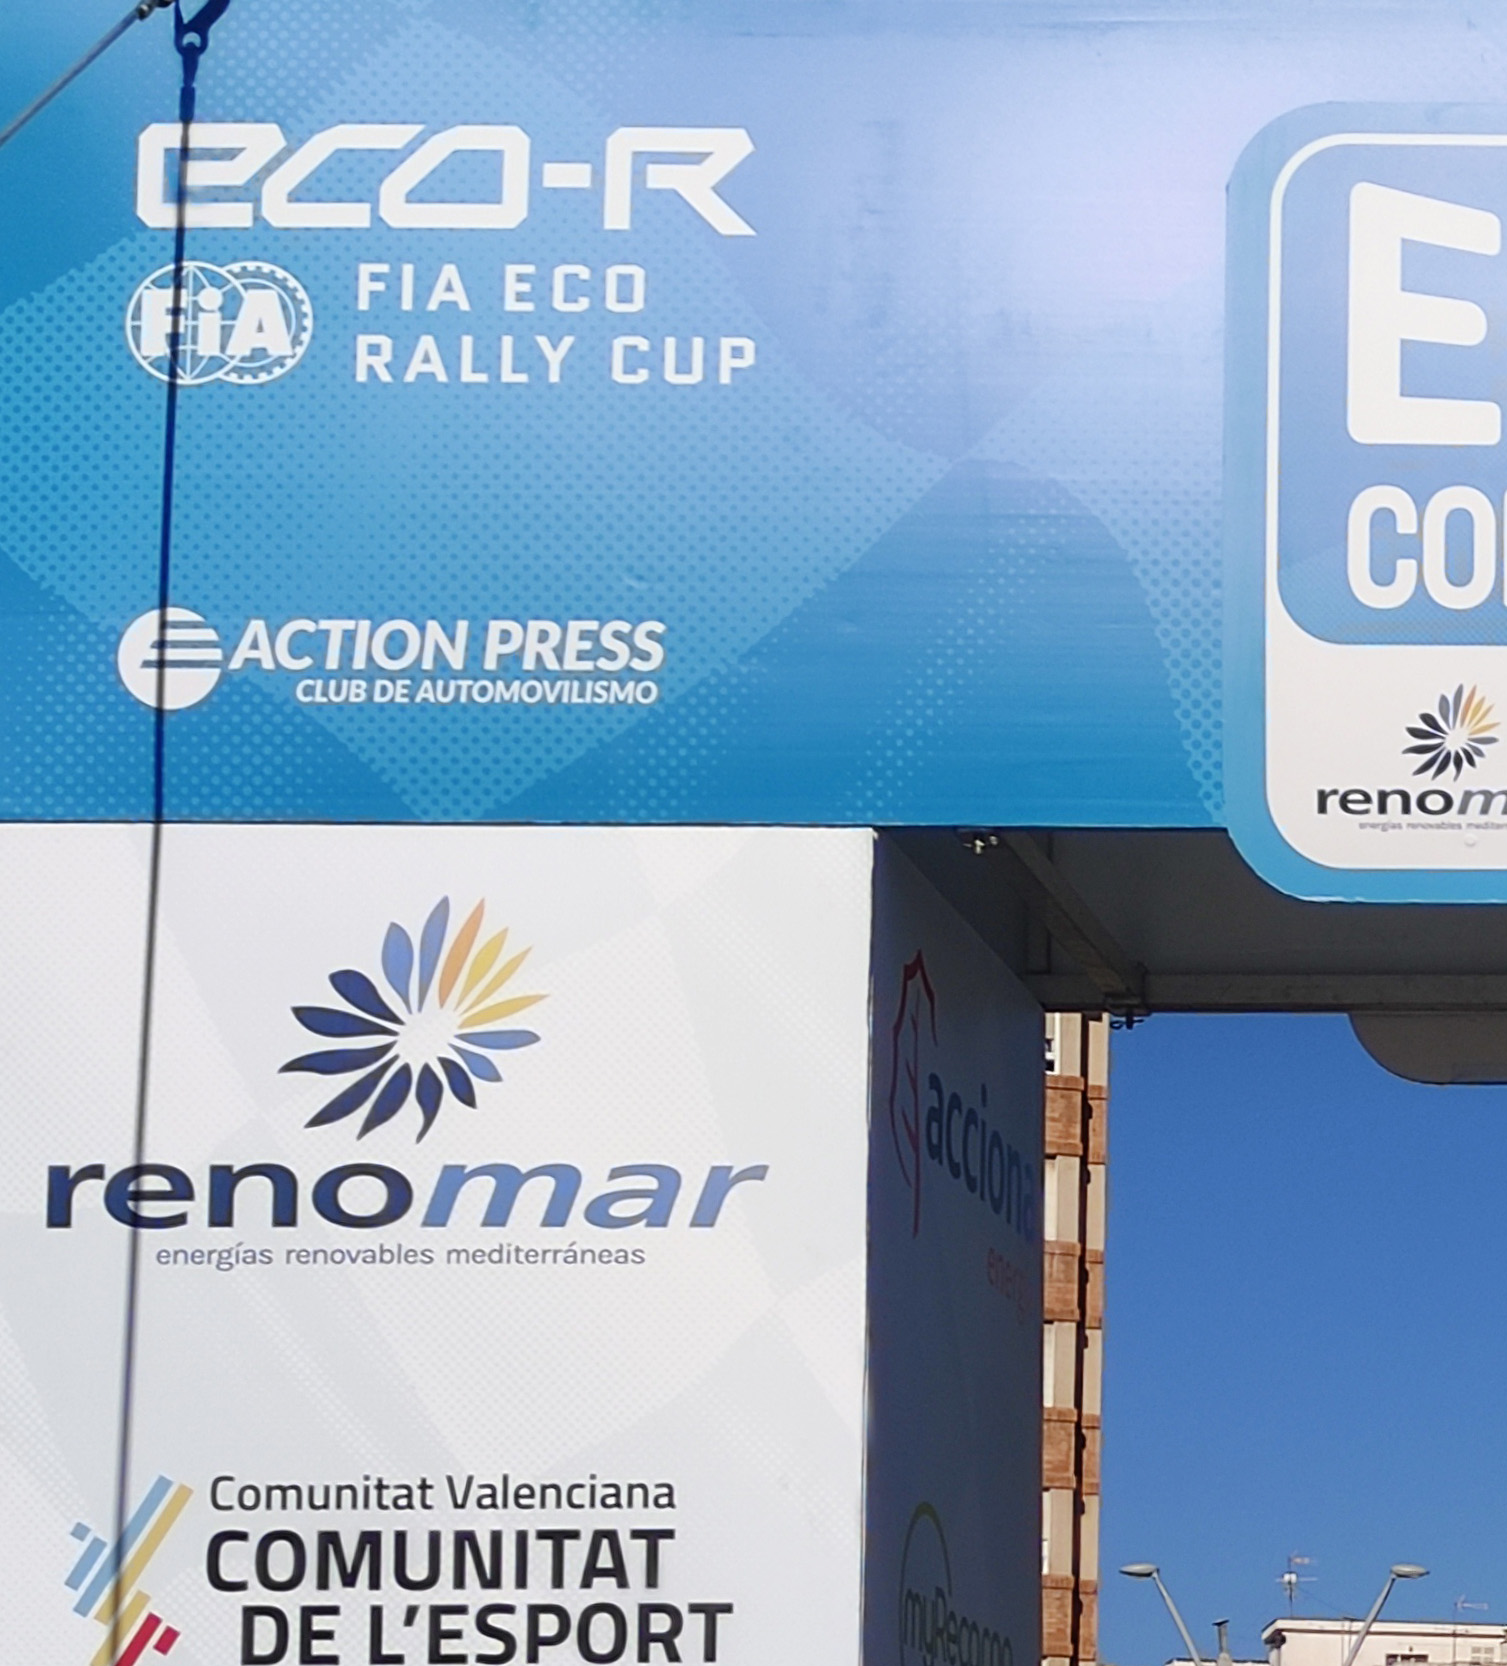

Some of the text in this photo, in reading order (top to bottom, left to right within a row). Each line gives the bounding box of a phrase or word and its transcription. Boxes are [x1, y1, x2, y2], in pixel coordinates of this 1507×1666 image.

[357, 263, 645, 313] FIA ECO
[355, 335, 756, 385] RALLY CUP
[228, 619, 666, 671] ACTION PRESS
[295, 678, 658, 704] CLUB DE AUTOMOVILISMO
[44, 1161, 769, 1230] renomar
[155, 1241, 646, 1272] energías renovables mediterráneas
[208, 1473, 677, 1511] Comunitat Valenciana
[205, 1527, 675, 1593] COMUNITAT
[239, 1601, 734, 1666] DE L'ESPORT
